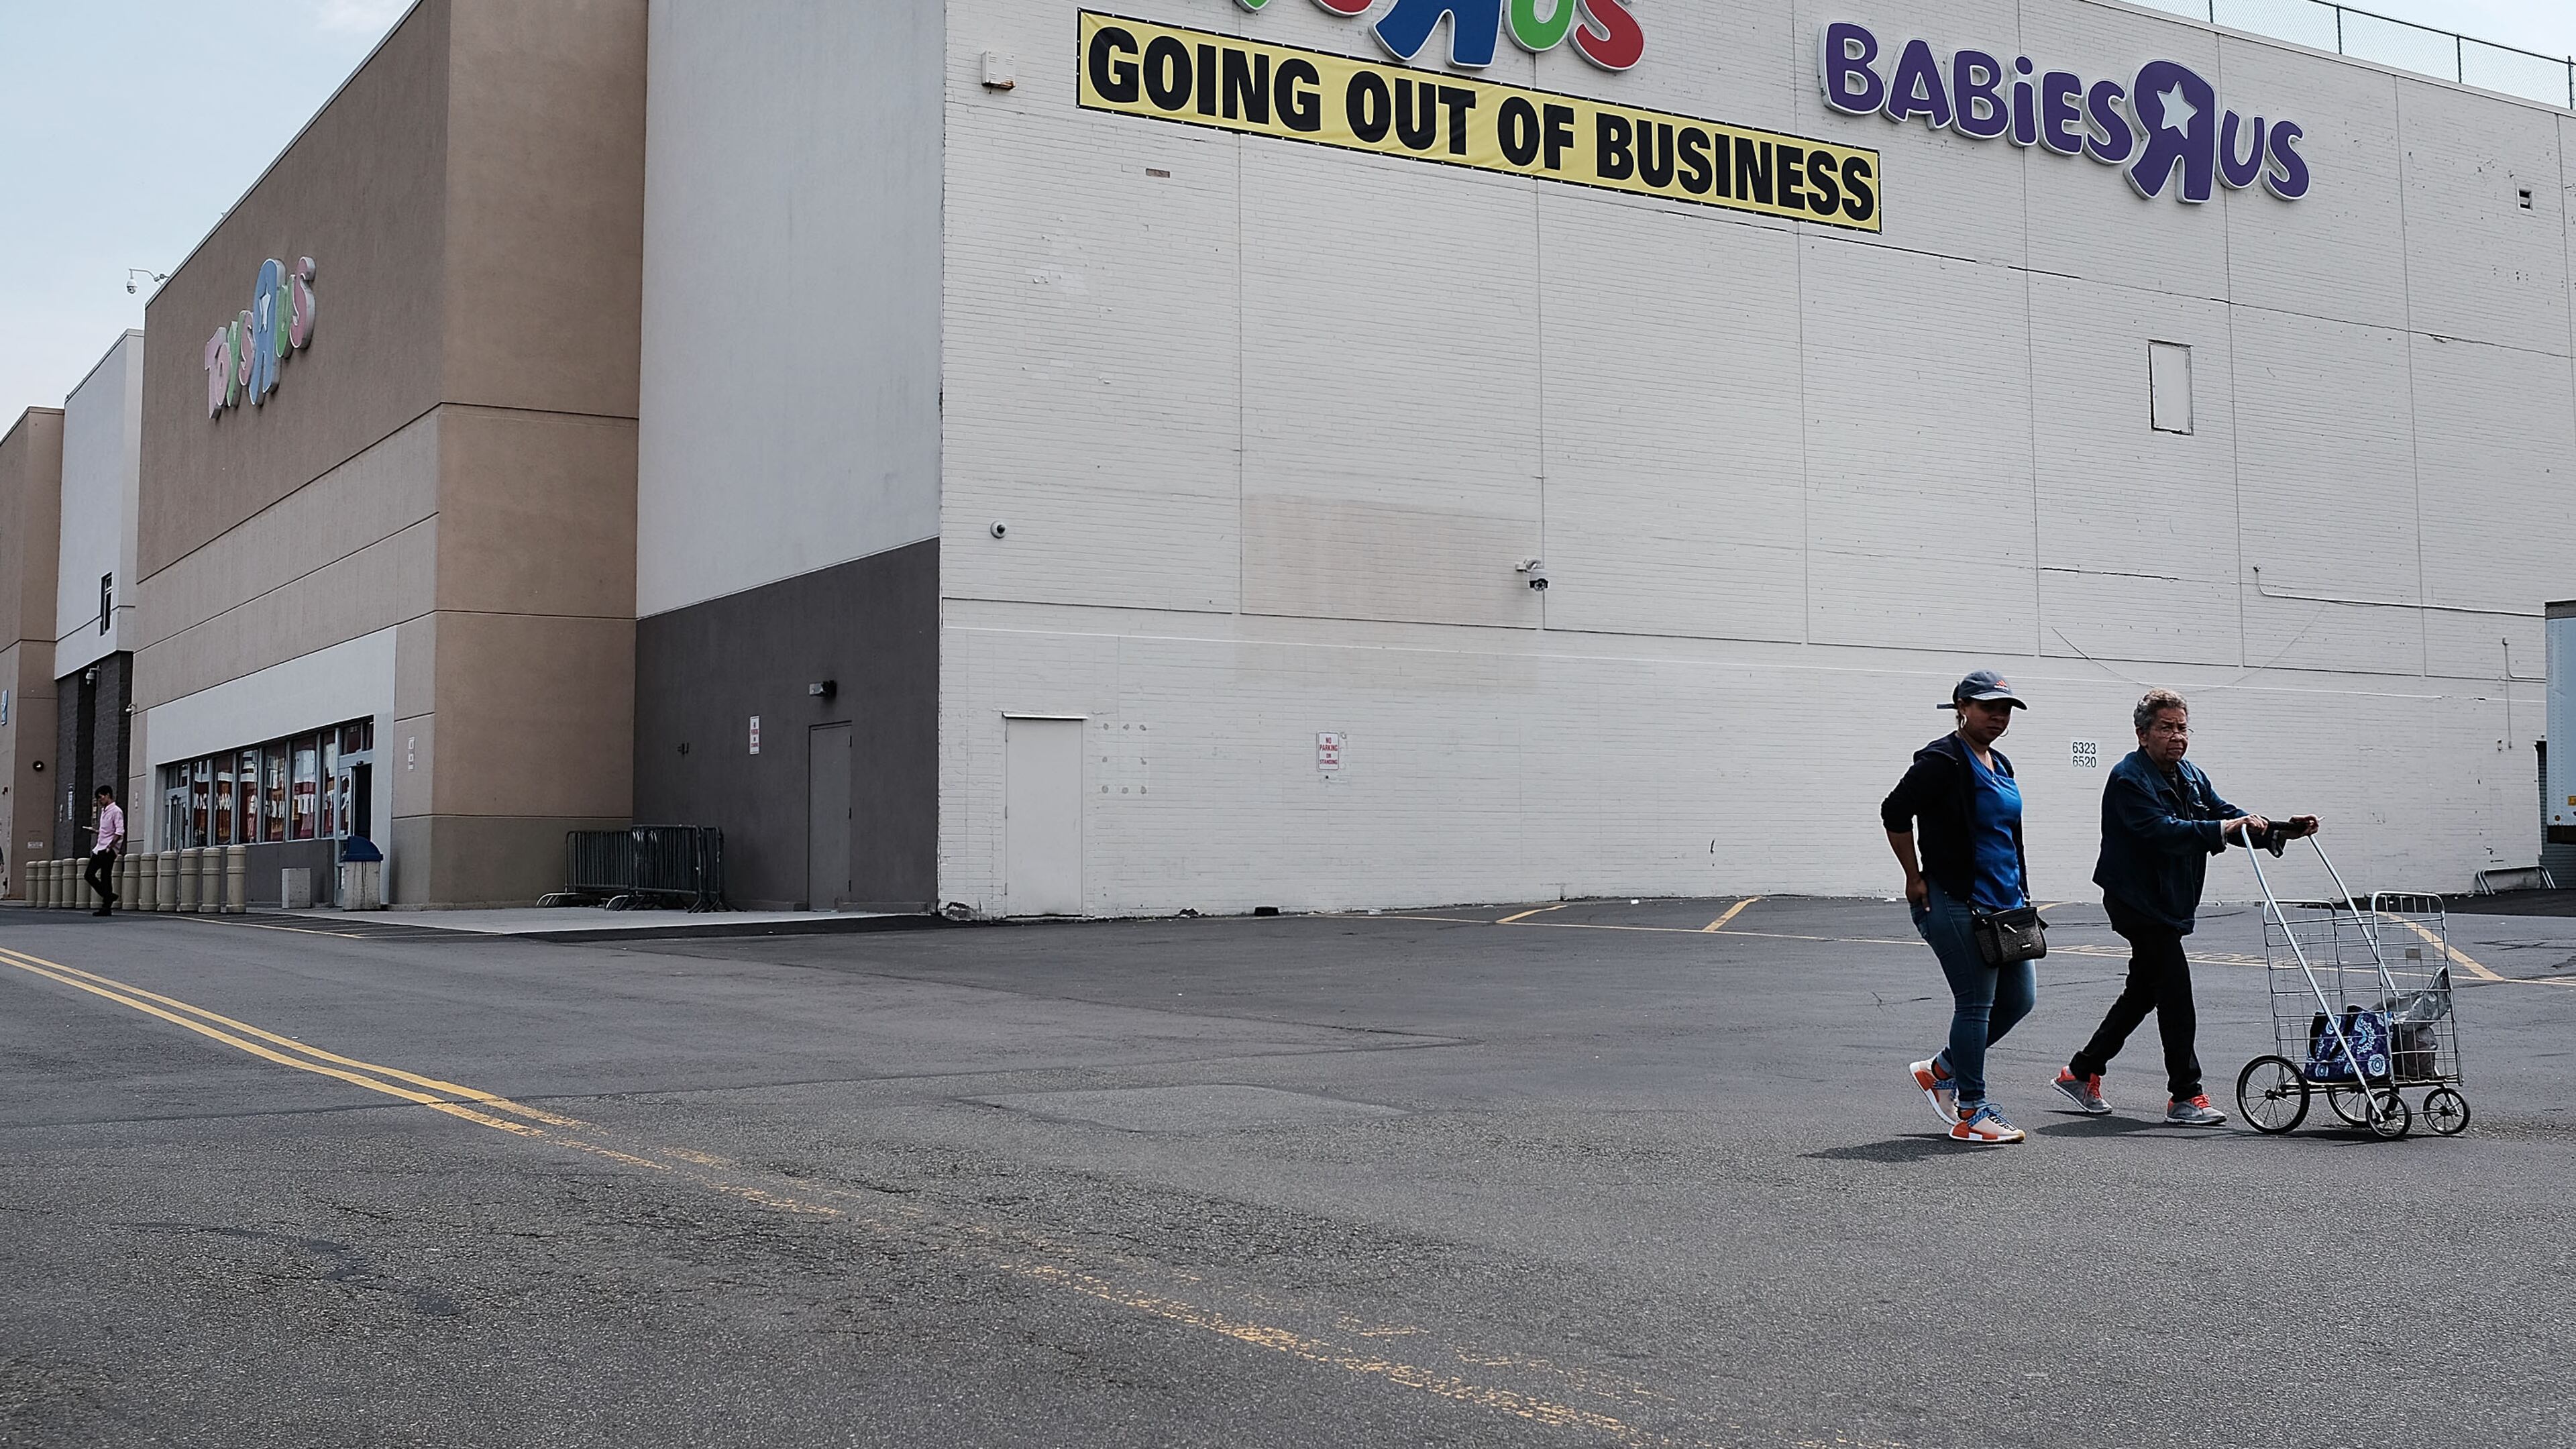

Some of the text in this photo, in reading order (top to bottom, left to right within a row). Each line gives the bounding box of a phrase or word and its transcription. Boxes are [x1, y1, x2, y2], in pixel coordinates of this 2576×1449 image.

[1087, 25, 1322, 133] GOING
[1345, 70, 1478, 156] OUT
[1497, 96, 1575, 171] OF
[1595, 111, 1876, 222] BUSINESS
[2072, 741, 2096, 754] 6323
[2072, 755, 2096, 767] 6520
